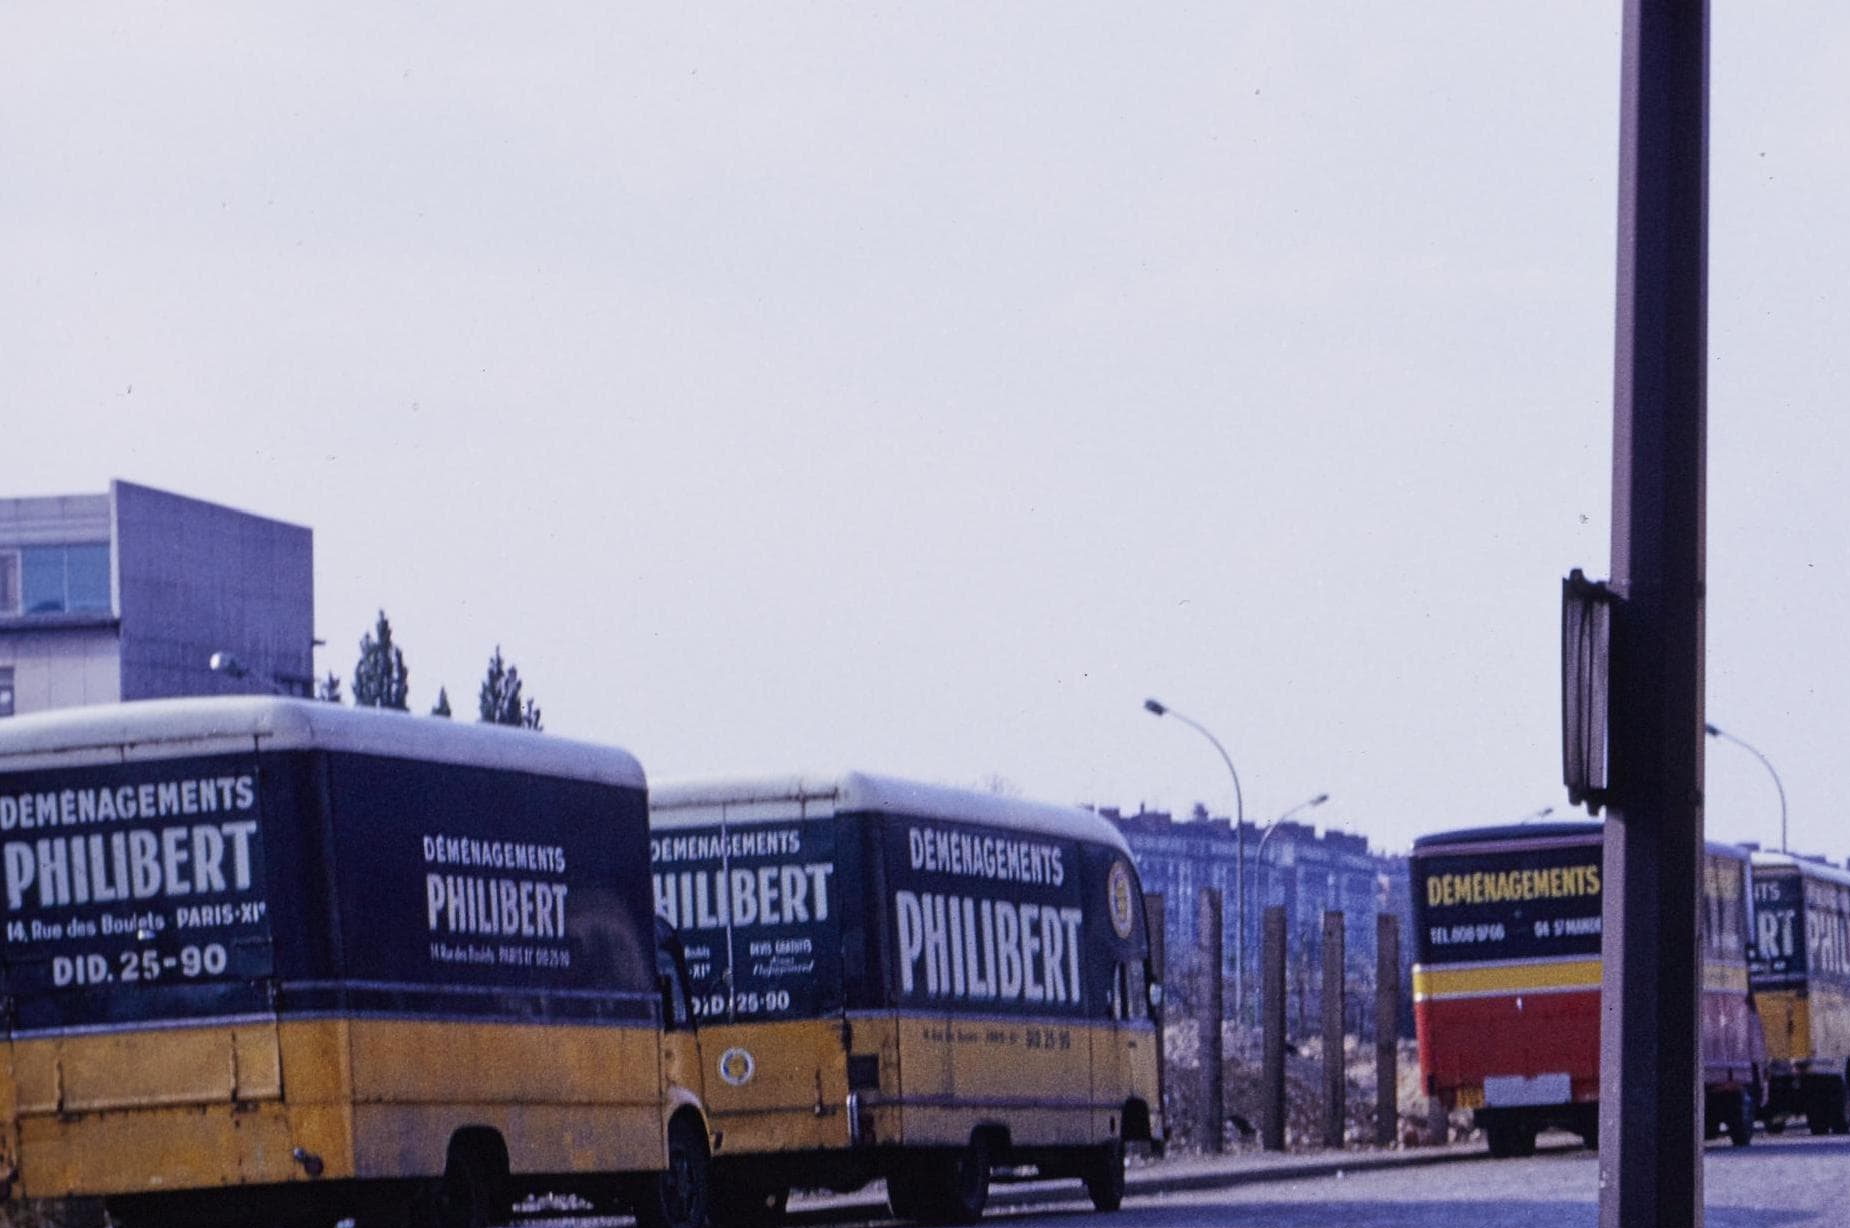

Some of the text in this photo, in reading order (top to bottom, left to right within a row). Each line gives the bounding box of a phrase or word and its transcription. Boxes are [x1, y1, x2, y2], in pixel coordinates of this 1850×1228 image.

[4, 820, 257, 911] PHILIBERT
[31, 919, 62, 939] Rue
[67, 917, 96, 937] des
[101, 911, 165, 935] Boulets
[426, 873, 568, 938] PHILIBERT
[53, 943, 227, 987] DID. 25-90
[896, 890, 1082, 1003] PHILIBERT
